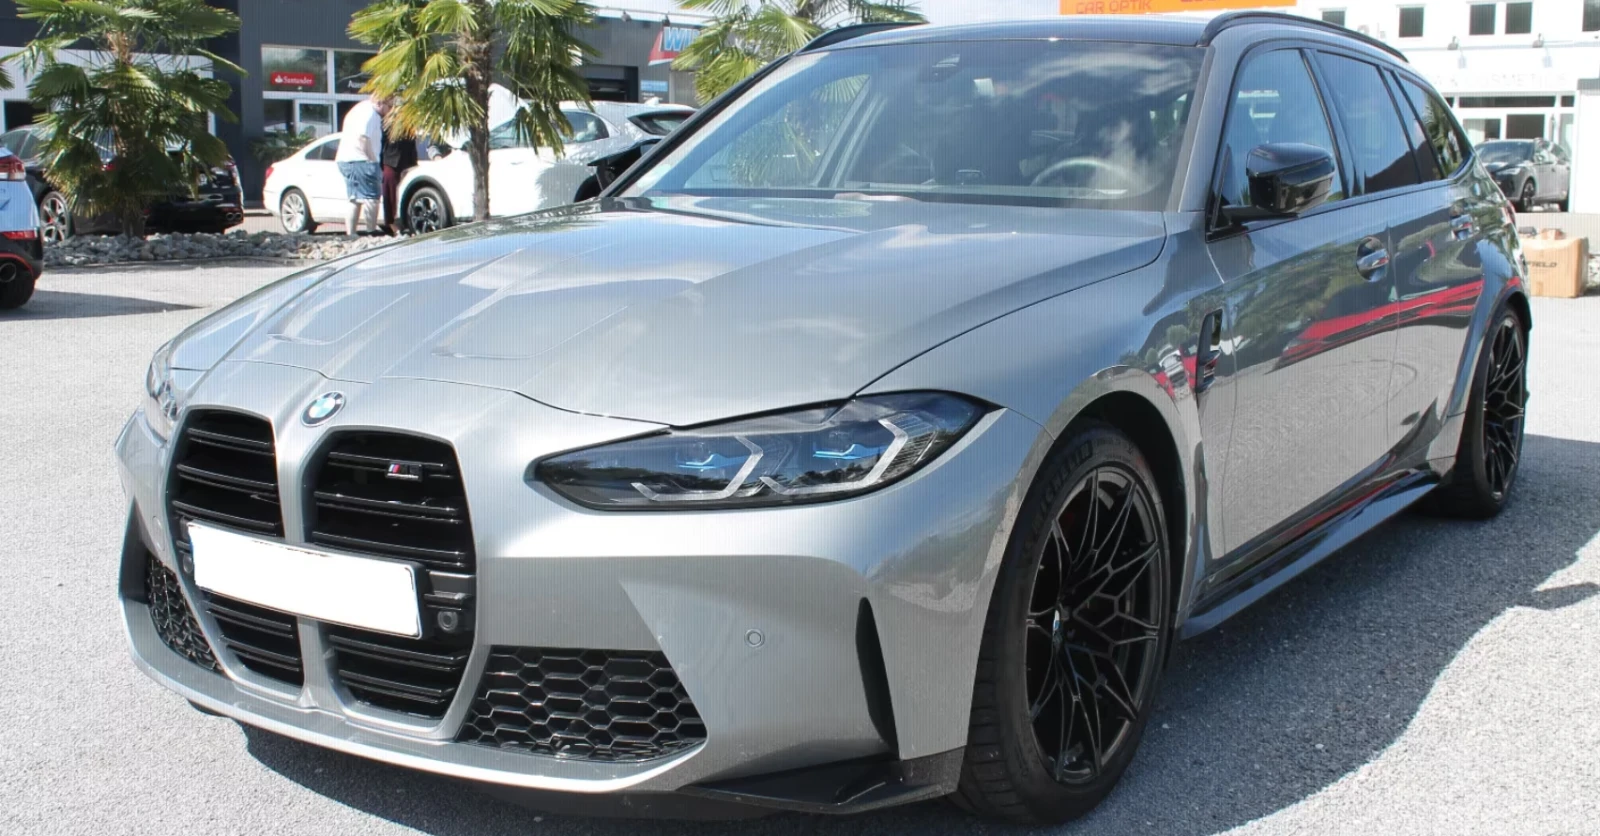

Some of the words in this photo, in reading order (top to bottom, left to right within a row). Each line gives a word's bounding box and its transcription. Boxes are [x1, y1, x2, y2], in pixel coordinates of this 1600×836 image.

[1075, 2, 1103, 14] CAR
[1107, 0, 1151, 13] OPTIK
[282, 76, 312, 85] Santander
